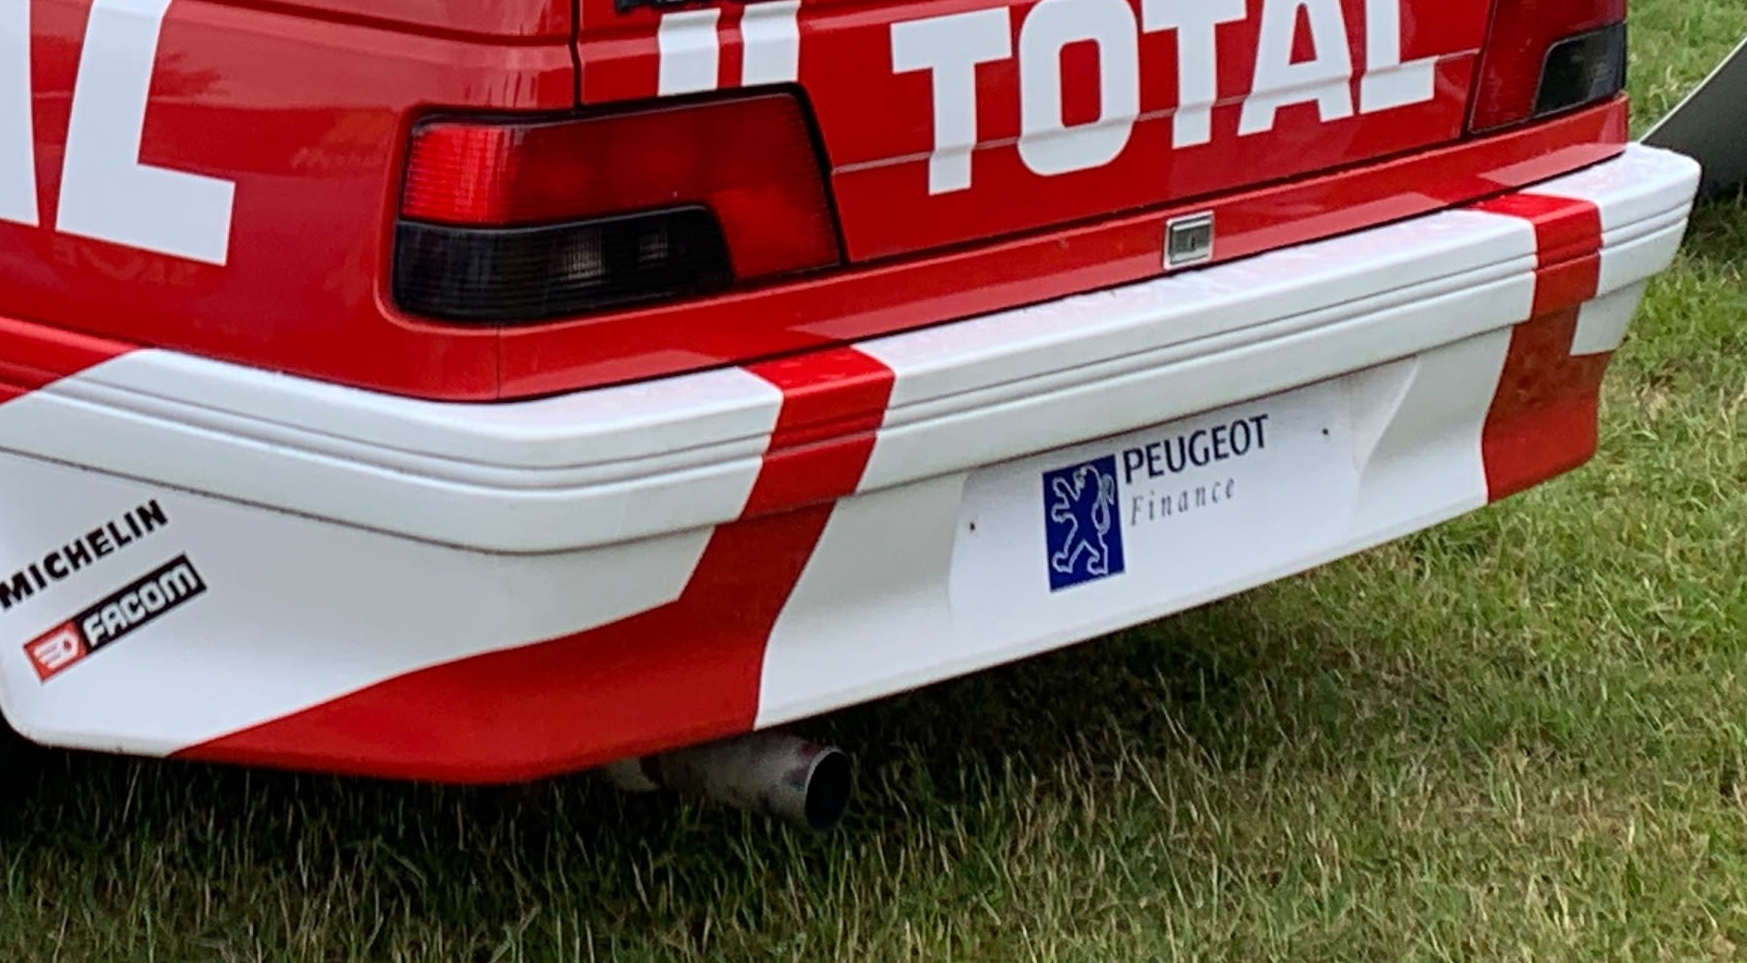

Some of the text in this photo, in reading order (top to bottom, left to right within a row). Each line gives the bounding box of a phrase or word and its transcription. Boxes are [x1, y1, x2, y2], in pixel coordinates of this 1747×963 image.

[1123, 414, 1269, 485] PEUGEOT
[1130, 477, 1237, 527] Finance
[82, 562, 199, 648] FACOM
